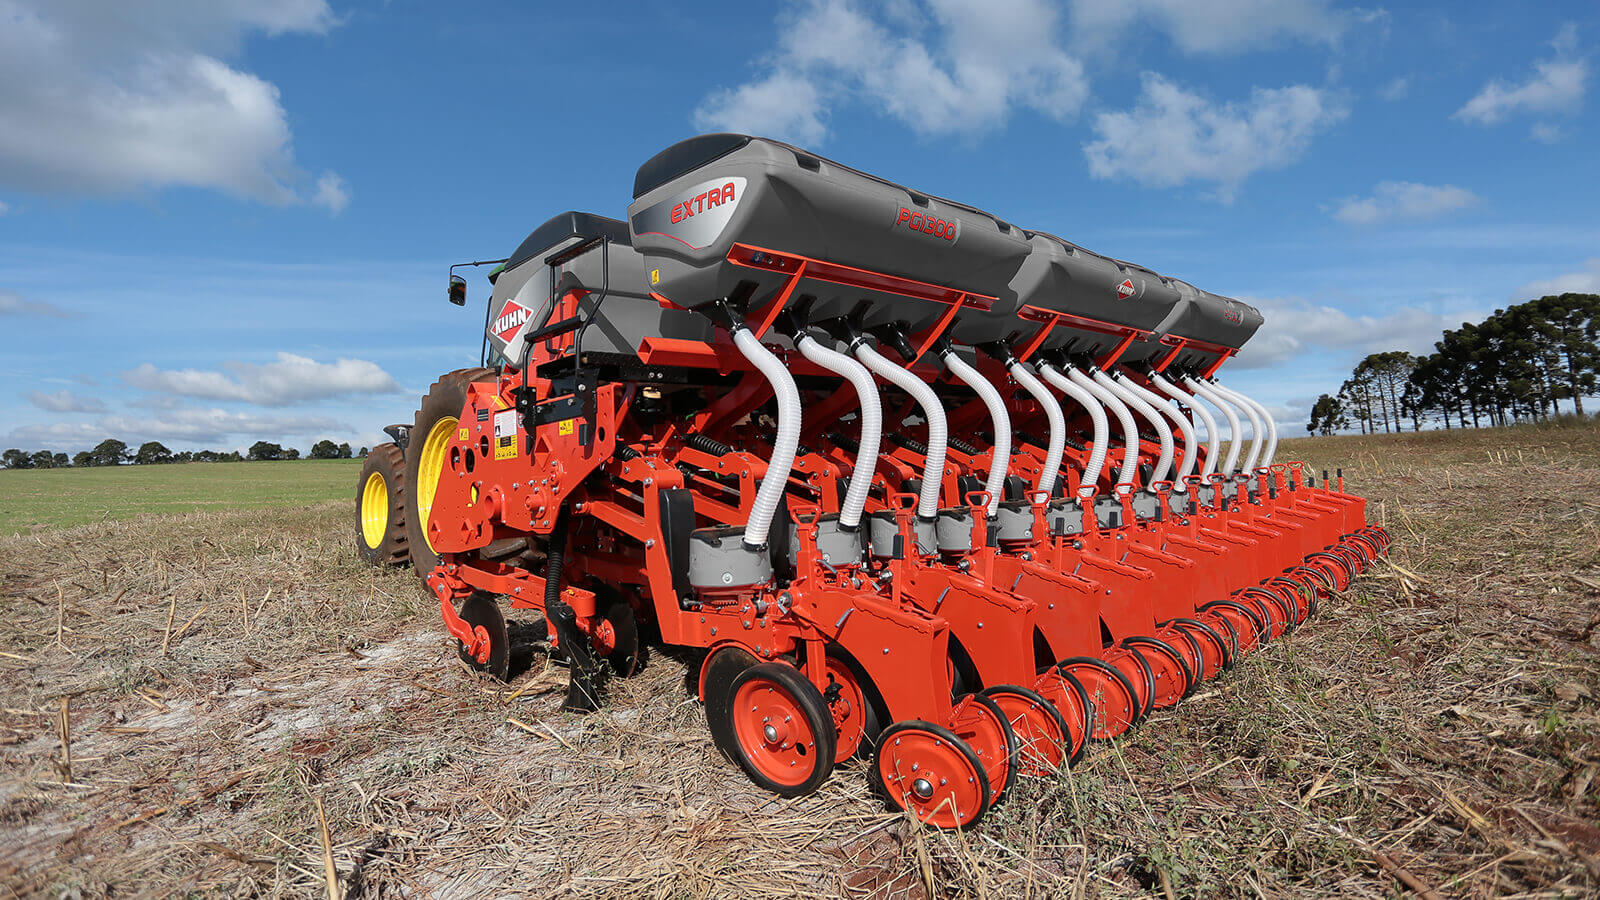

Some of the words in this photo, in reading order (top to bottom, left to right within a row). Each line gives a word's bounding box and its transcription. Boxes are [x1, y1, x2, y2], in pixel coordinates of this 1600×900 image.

[670, 182, 735, 224] EXTRA
[896, 207, 956, 240] PG1300
[494, 307, 527, 336] KUHN
